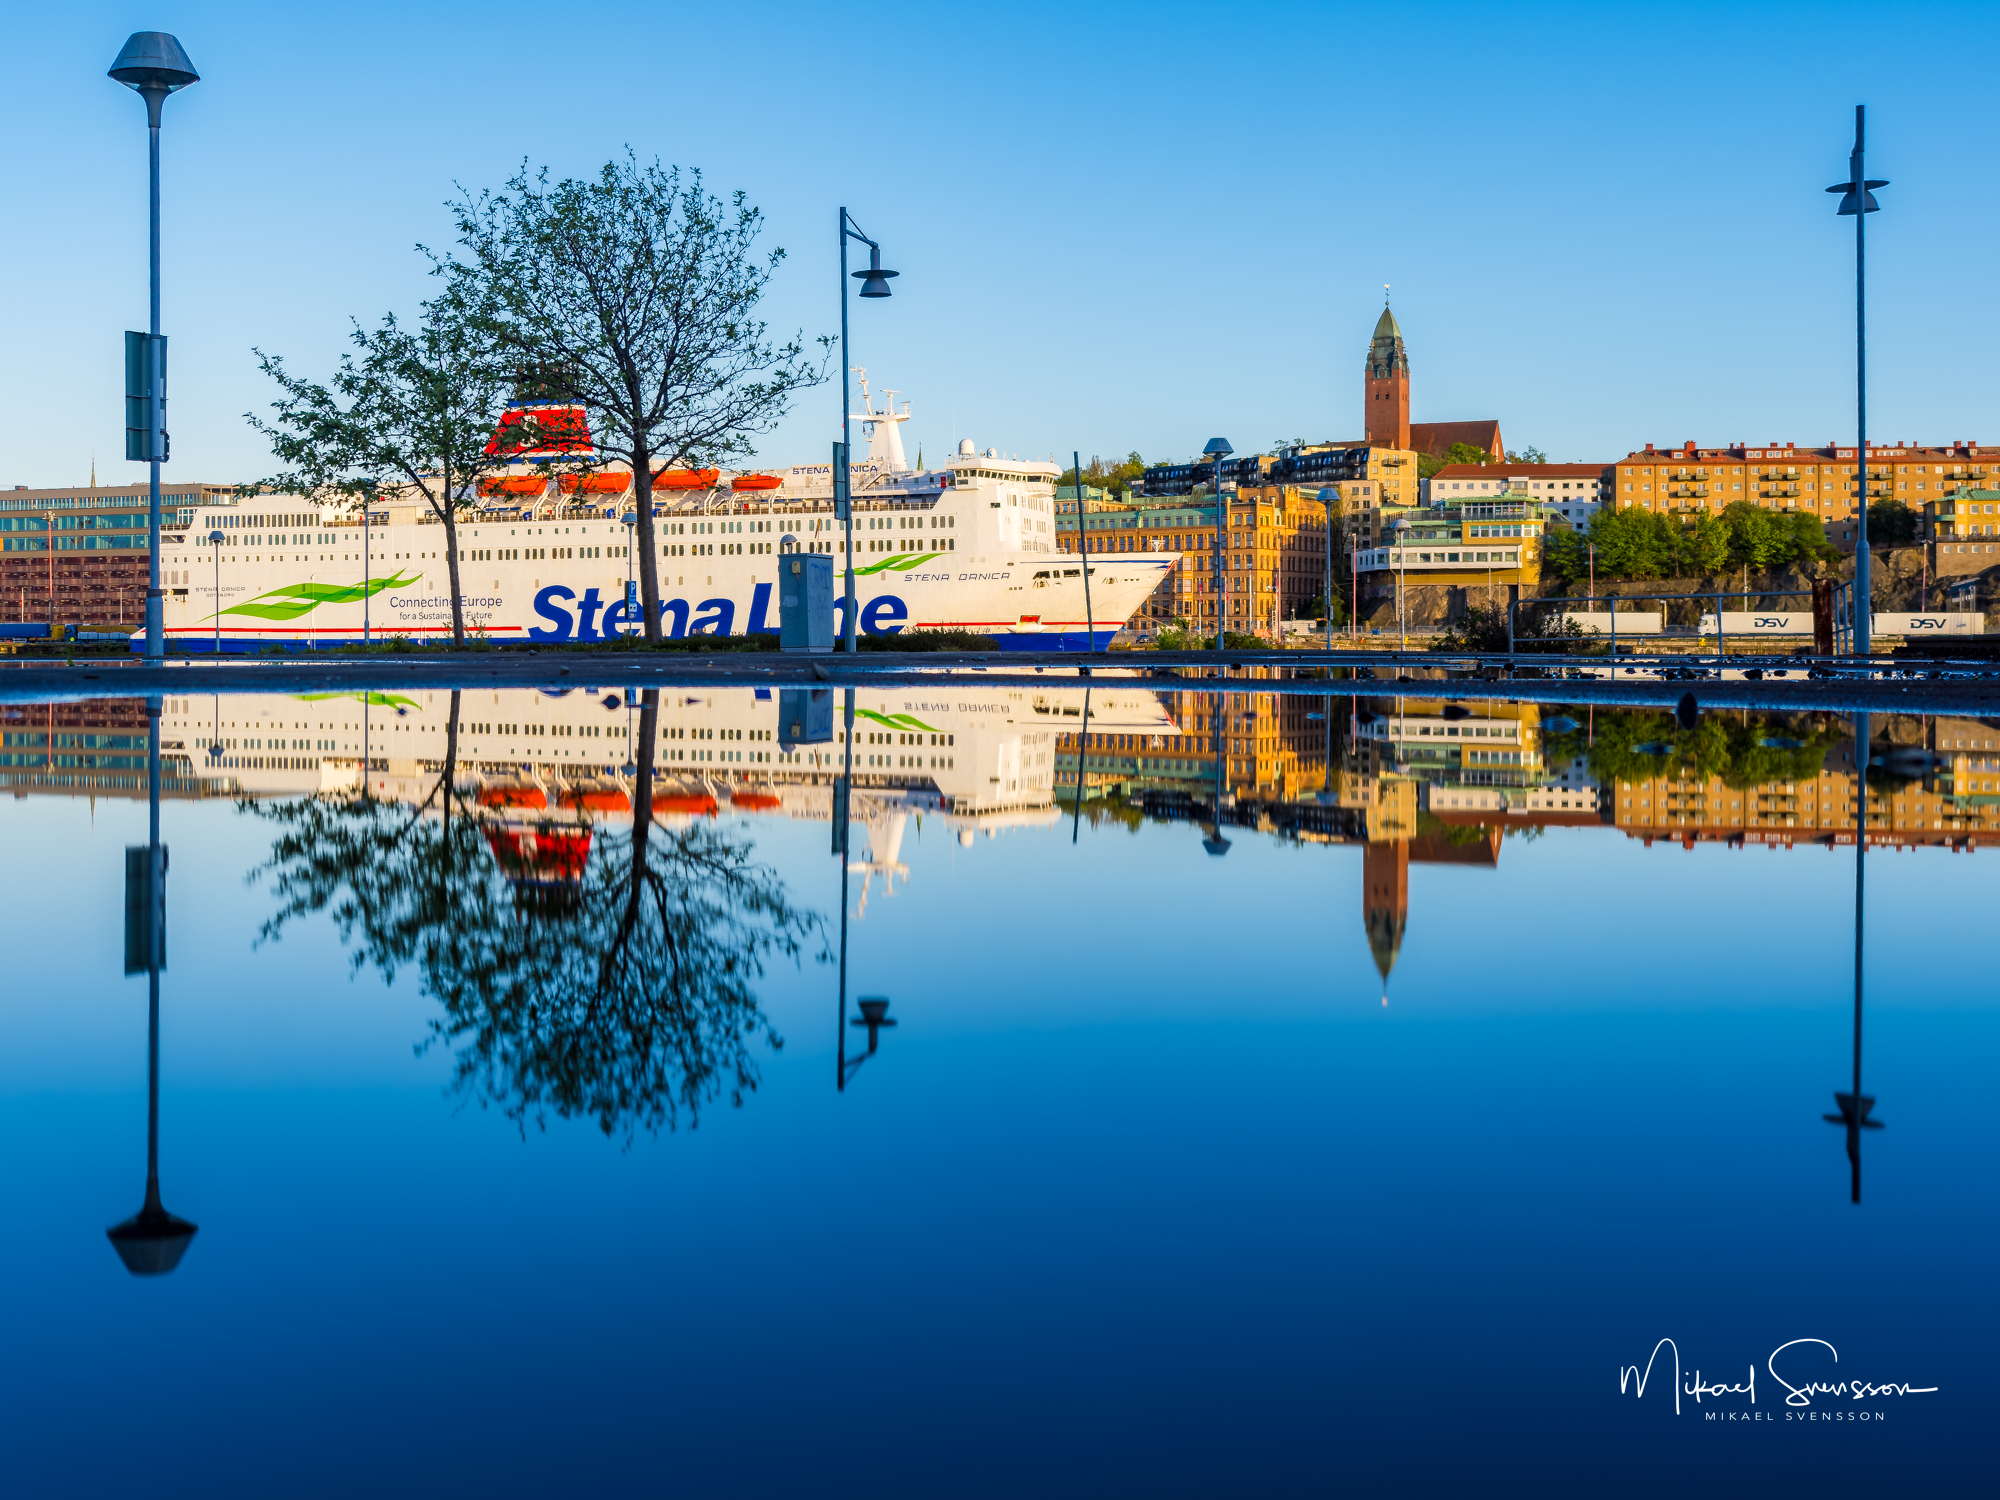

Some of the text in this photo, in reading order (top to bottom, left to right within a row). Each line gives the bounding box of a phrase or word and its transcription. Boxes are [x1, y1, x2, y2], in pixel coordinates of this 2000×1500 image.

[792, 467, 830, 475] STENA
[958, 572, 1011, 580] DANICA
[630, 582, 636, 594] P
[459, 595, 503, 608] Europe
[400, 612, 410, 620] for
[418, 612, 464, 620] Sustainae
[466, 611, 493, 620] Future
[528, 585, 735, 638] Stena
[744, 583, 908, 638] Le
[1754, 618, 1790, 628] DSV
[1910, 618, 1946, 628] DSV
